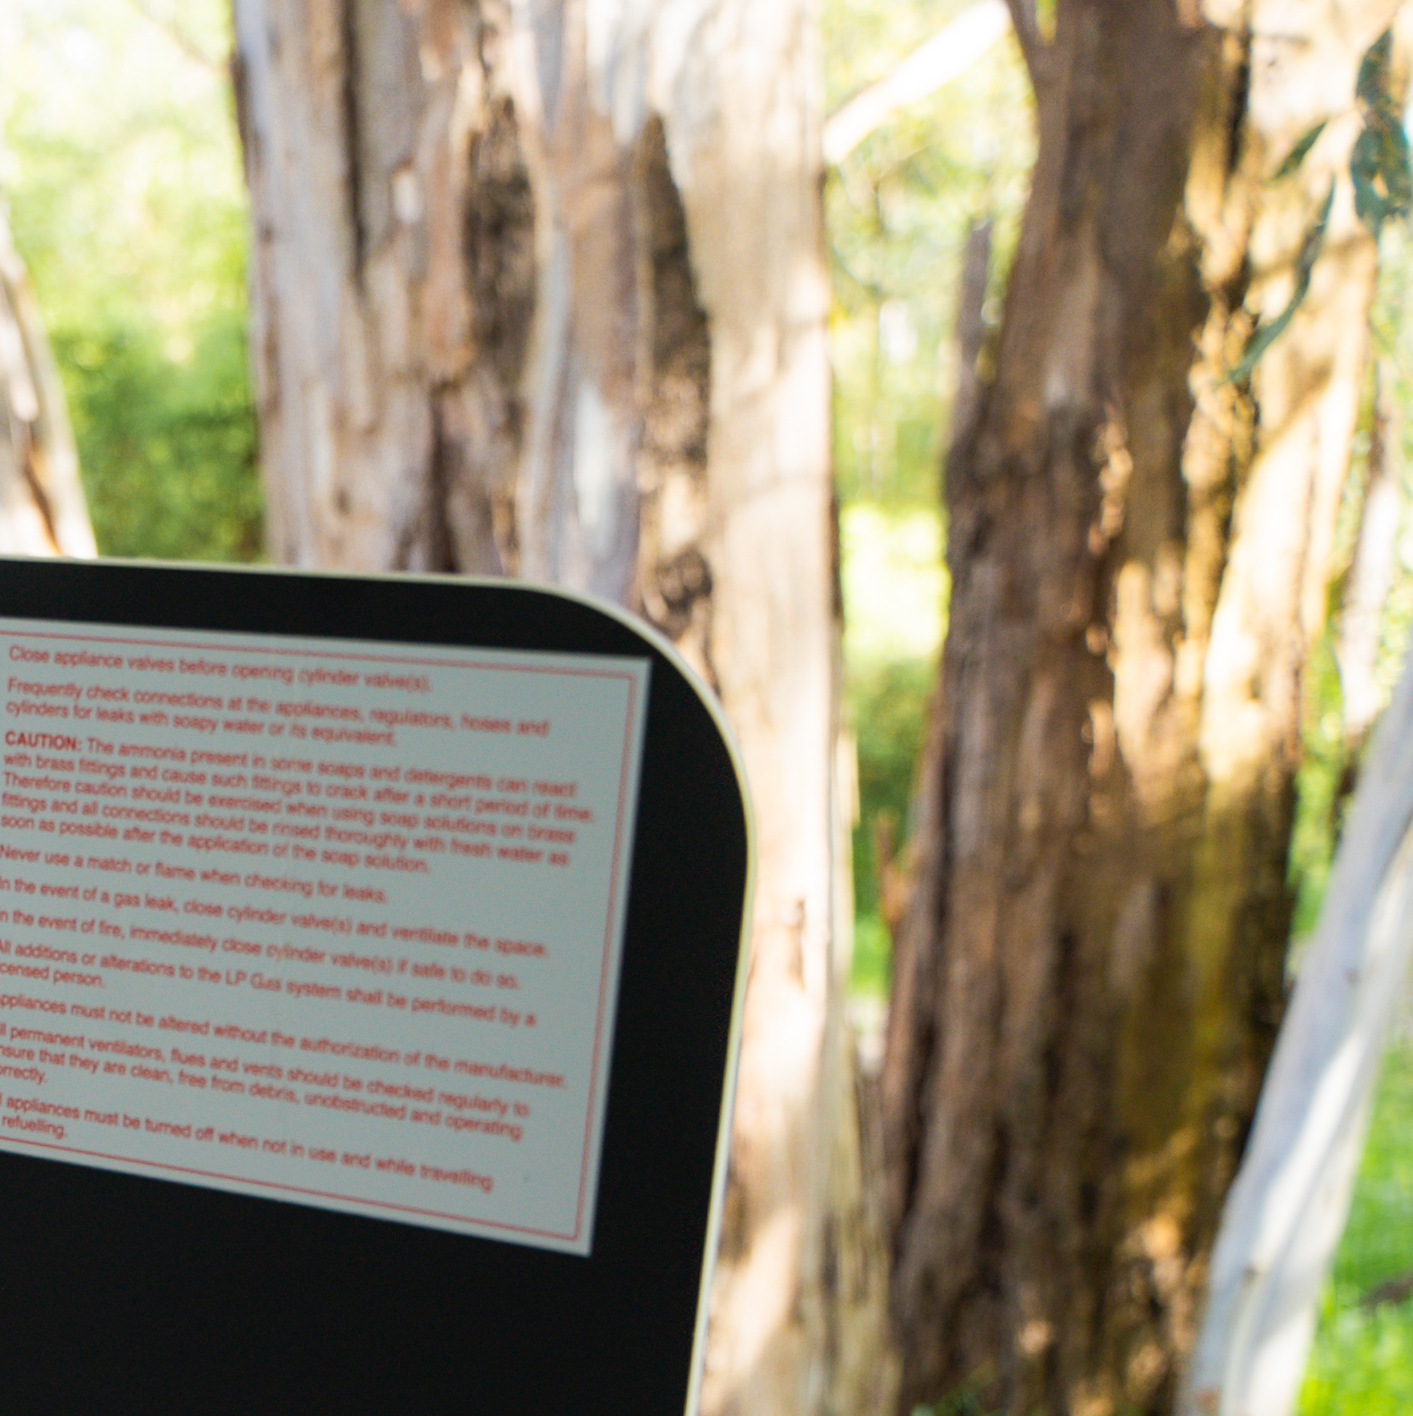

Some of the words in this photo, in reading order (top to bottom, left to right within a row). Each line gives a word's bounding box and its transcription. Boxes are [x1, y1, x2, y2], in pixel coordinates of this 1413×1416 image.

[8, 644, 50, 662] Close
[53, 650, 123, 668] appliance
[127, 655, 175, 672] valves
[178, 658, 228, 676] before
[230, 663, 294, 684] opening
[297, 666, 360, 686] cylinder
[44, 852, 70, 866] use
[73, 855, 83, 868] a
[87, 856, 131, 872] match
[135, 862, 151, 875] or
[154, 861, 196, 880] flame
[199, 868, 241, 885] when
[243, 873, 313, 898] checking
[316, 880, 339, 897] for
